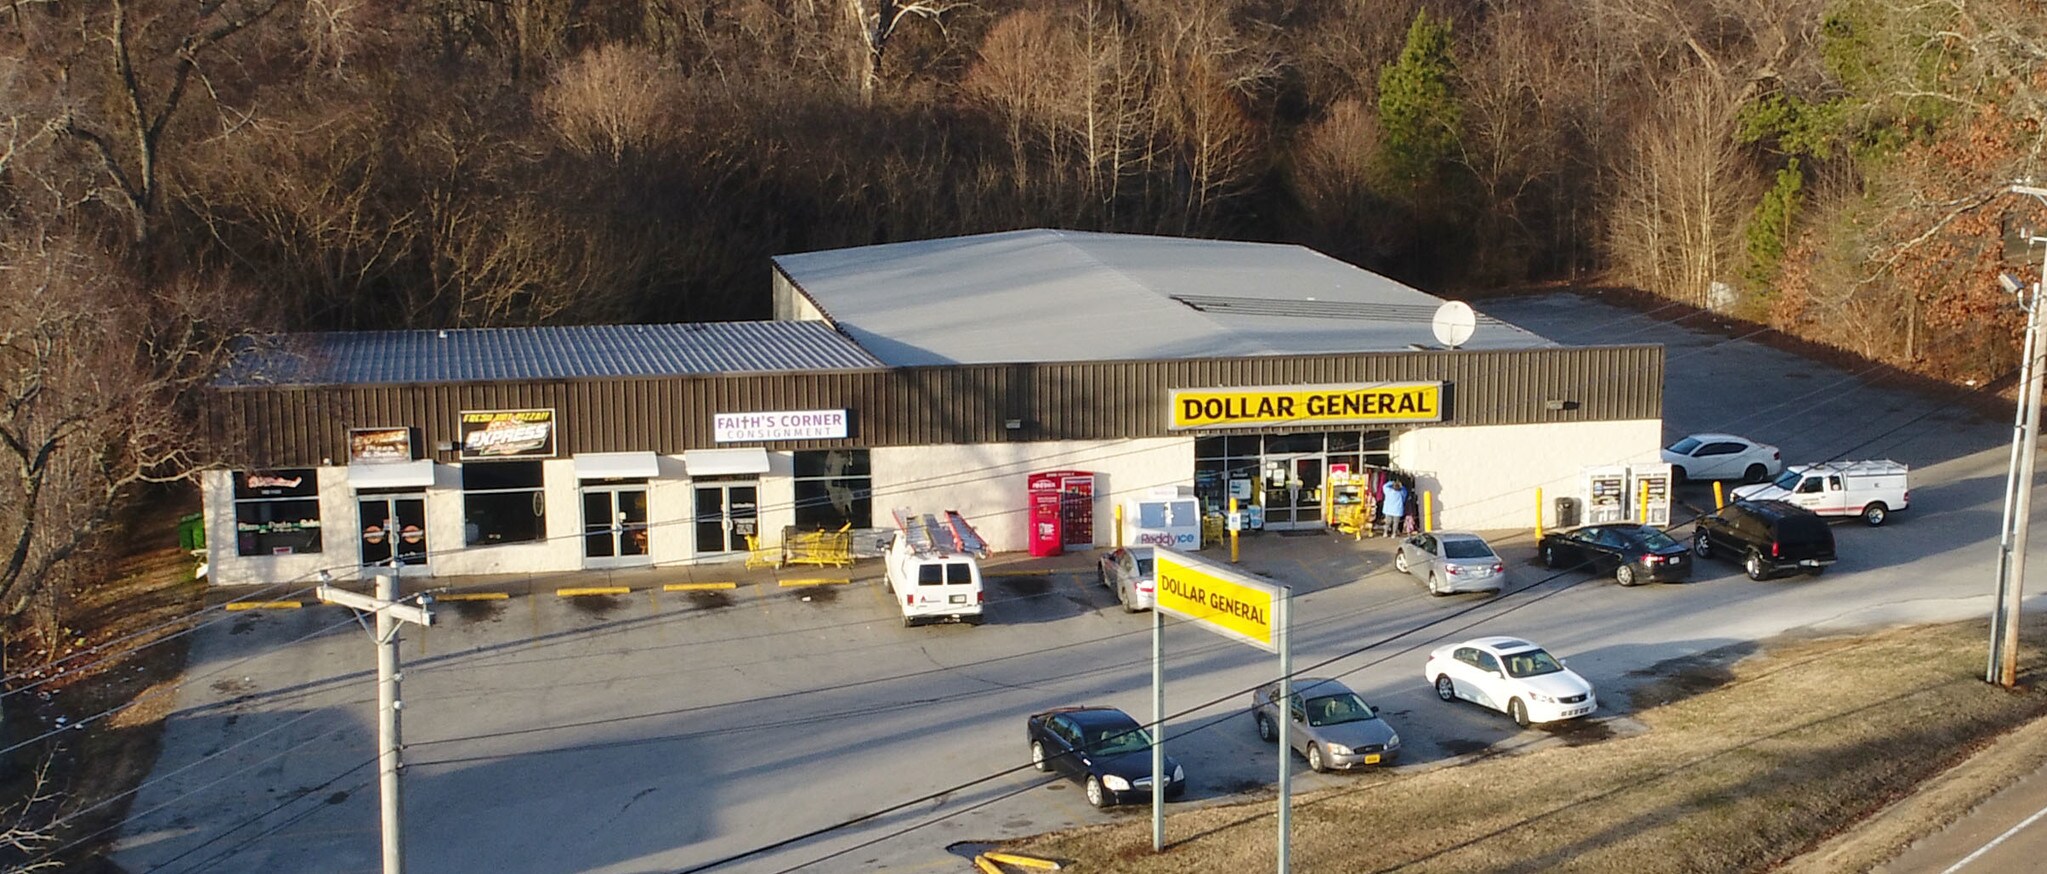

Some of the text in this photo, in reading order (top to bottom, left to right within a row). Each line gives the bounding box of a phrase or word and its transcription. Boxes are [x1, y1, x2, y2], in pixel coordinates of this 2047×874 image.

[1182, 391, 1431, 420] DOLLAR GENERAL
[717, 413, 842, 430] FAITH'S CORNER
[727, 427, 832, 440] CONSIGNMENT
[466, 423, 550, 448] EXPRESS
[1161, 574, 1267, 625] DOLLAR GENERAL
